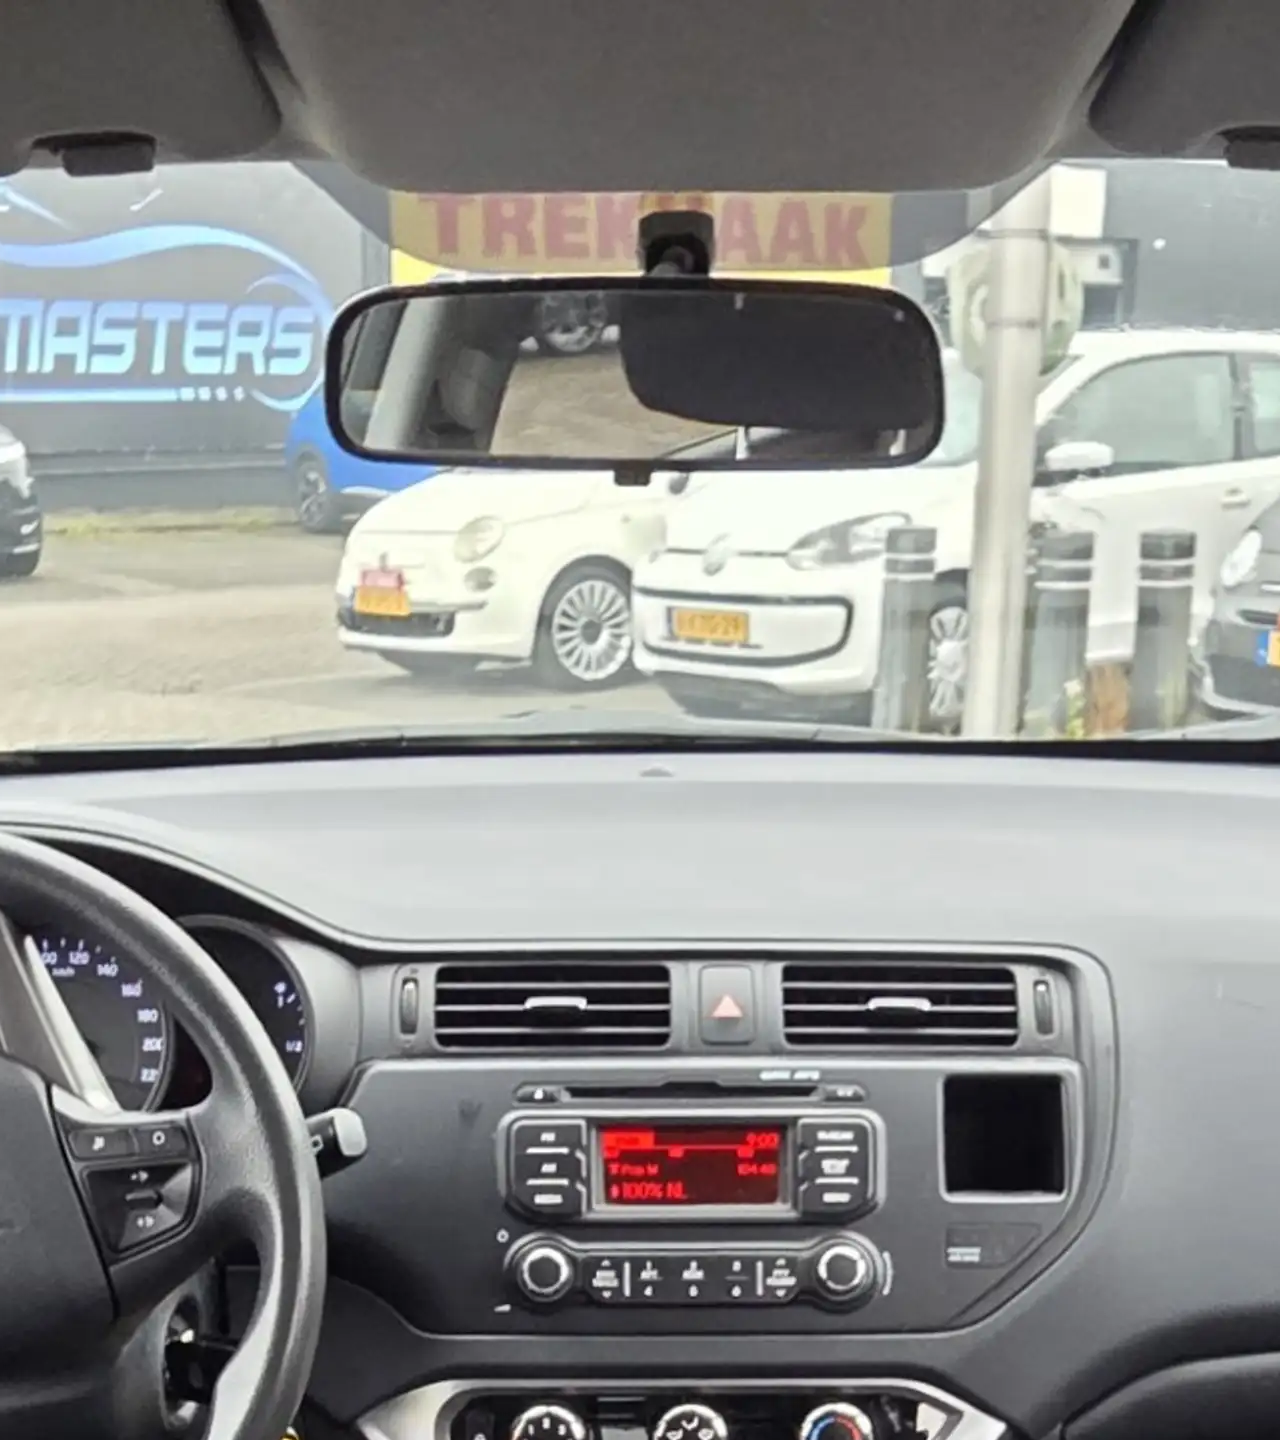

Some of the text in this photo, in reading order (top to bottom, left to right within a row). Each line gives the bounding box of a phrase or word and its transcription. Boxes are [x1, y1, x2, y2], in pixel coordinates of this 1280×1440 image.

[420, 194, 869, 268] TREKAAK
[41, 952, 58, 965] 00
[69, 952, 90, 965] 120
[97, 964, 119, 977] 140
